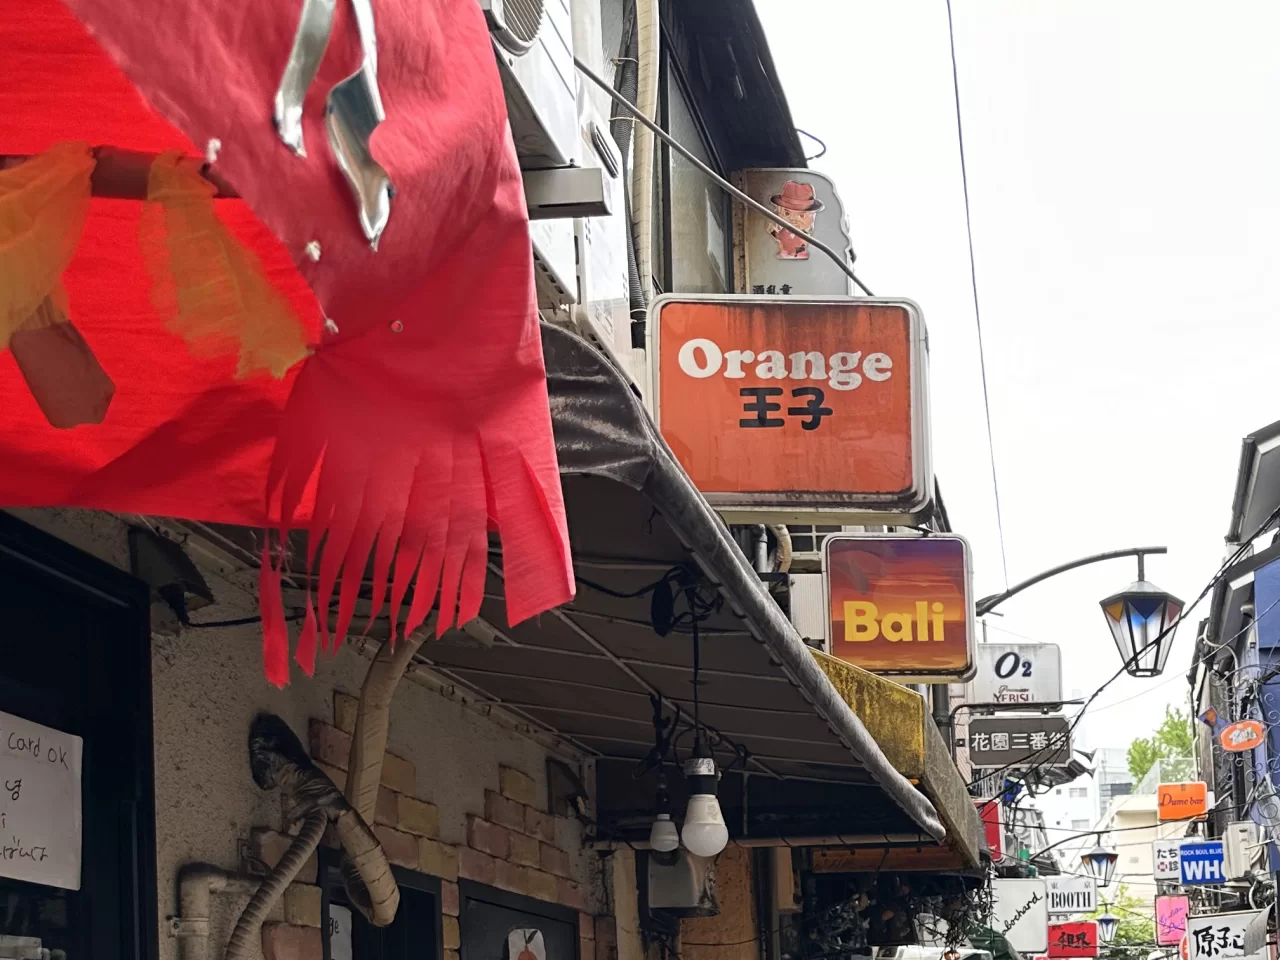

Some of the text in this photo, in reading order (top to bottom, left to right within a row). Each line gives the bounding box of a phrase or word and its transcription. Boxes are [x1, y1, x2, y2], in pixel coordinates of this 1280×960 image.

[678, 338, 893, 391] Orange
[739, 386, 833, 430] 王子
[843, 600, 945, 642] Bali
[971, 732, 1068, 751] 花園三番街
[1183, 860, 1225, 881] WH
